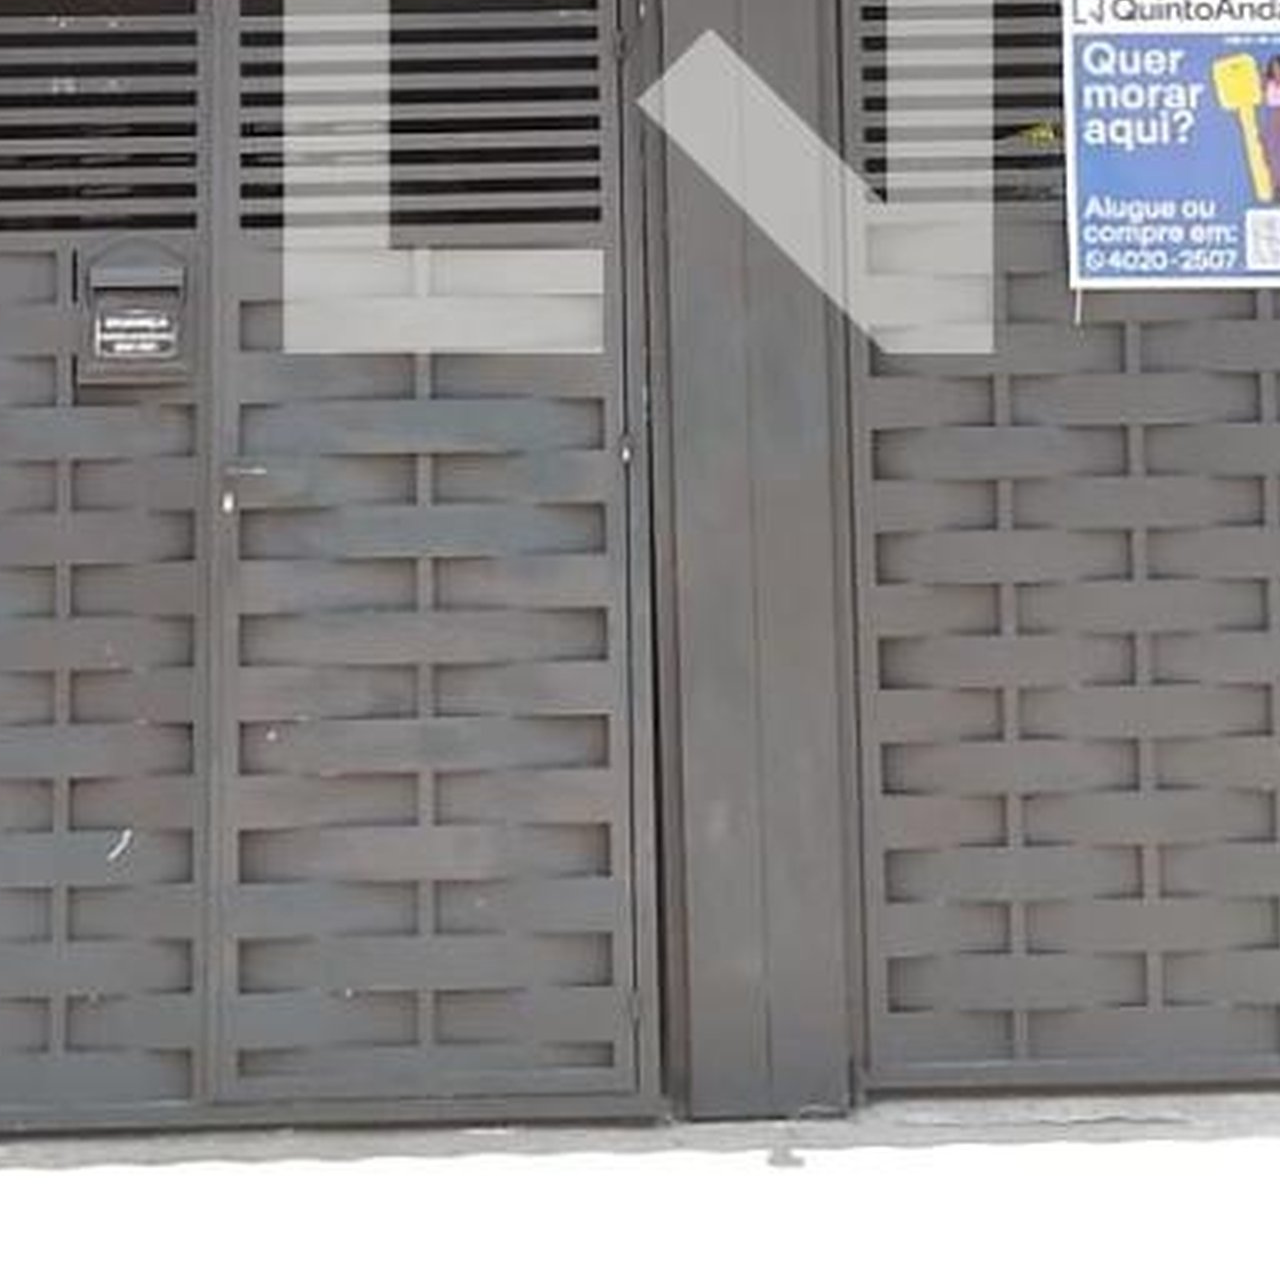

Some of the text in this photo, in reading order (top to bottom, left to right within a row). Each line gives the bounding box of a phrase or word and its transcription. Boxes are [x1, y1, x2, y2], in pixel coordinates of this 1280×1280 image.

[1082, 41, 1184, 77] Quer
[1082, 81, 1204, 109] morar
[1082, 110, 1194, 150] aqui?
[1083, 195, 1216, 224] Alugue ou
[1083, 223, 1240, 246] compre em:
[1108, 248, 1238, 271] 4020-2507
